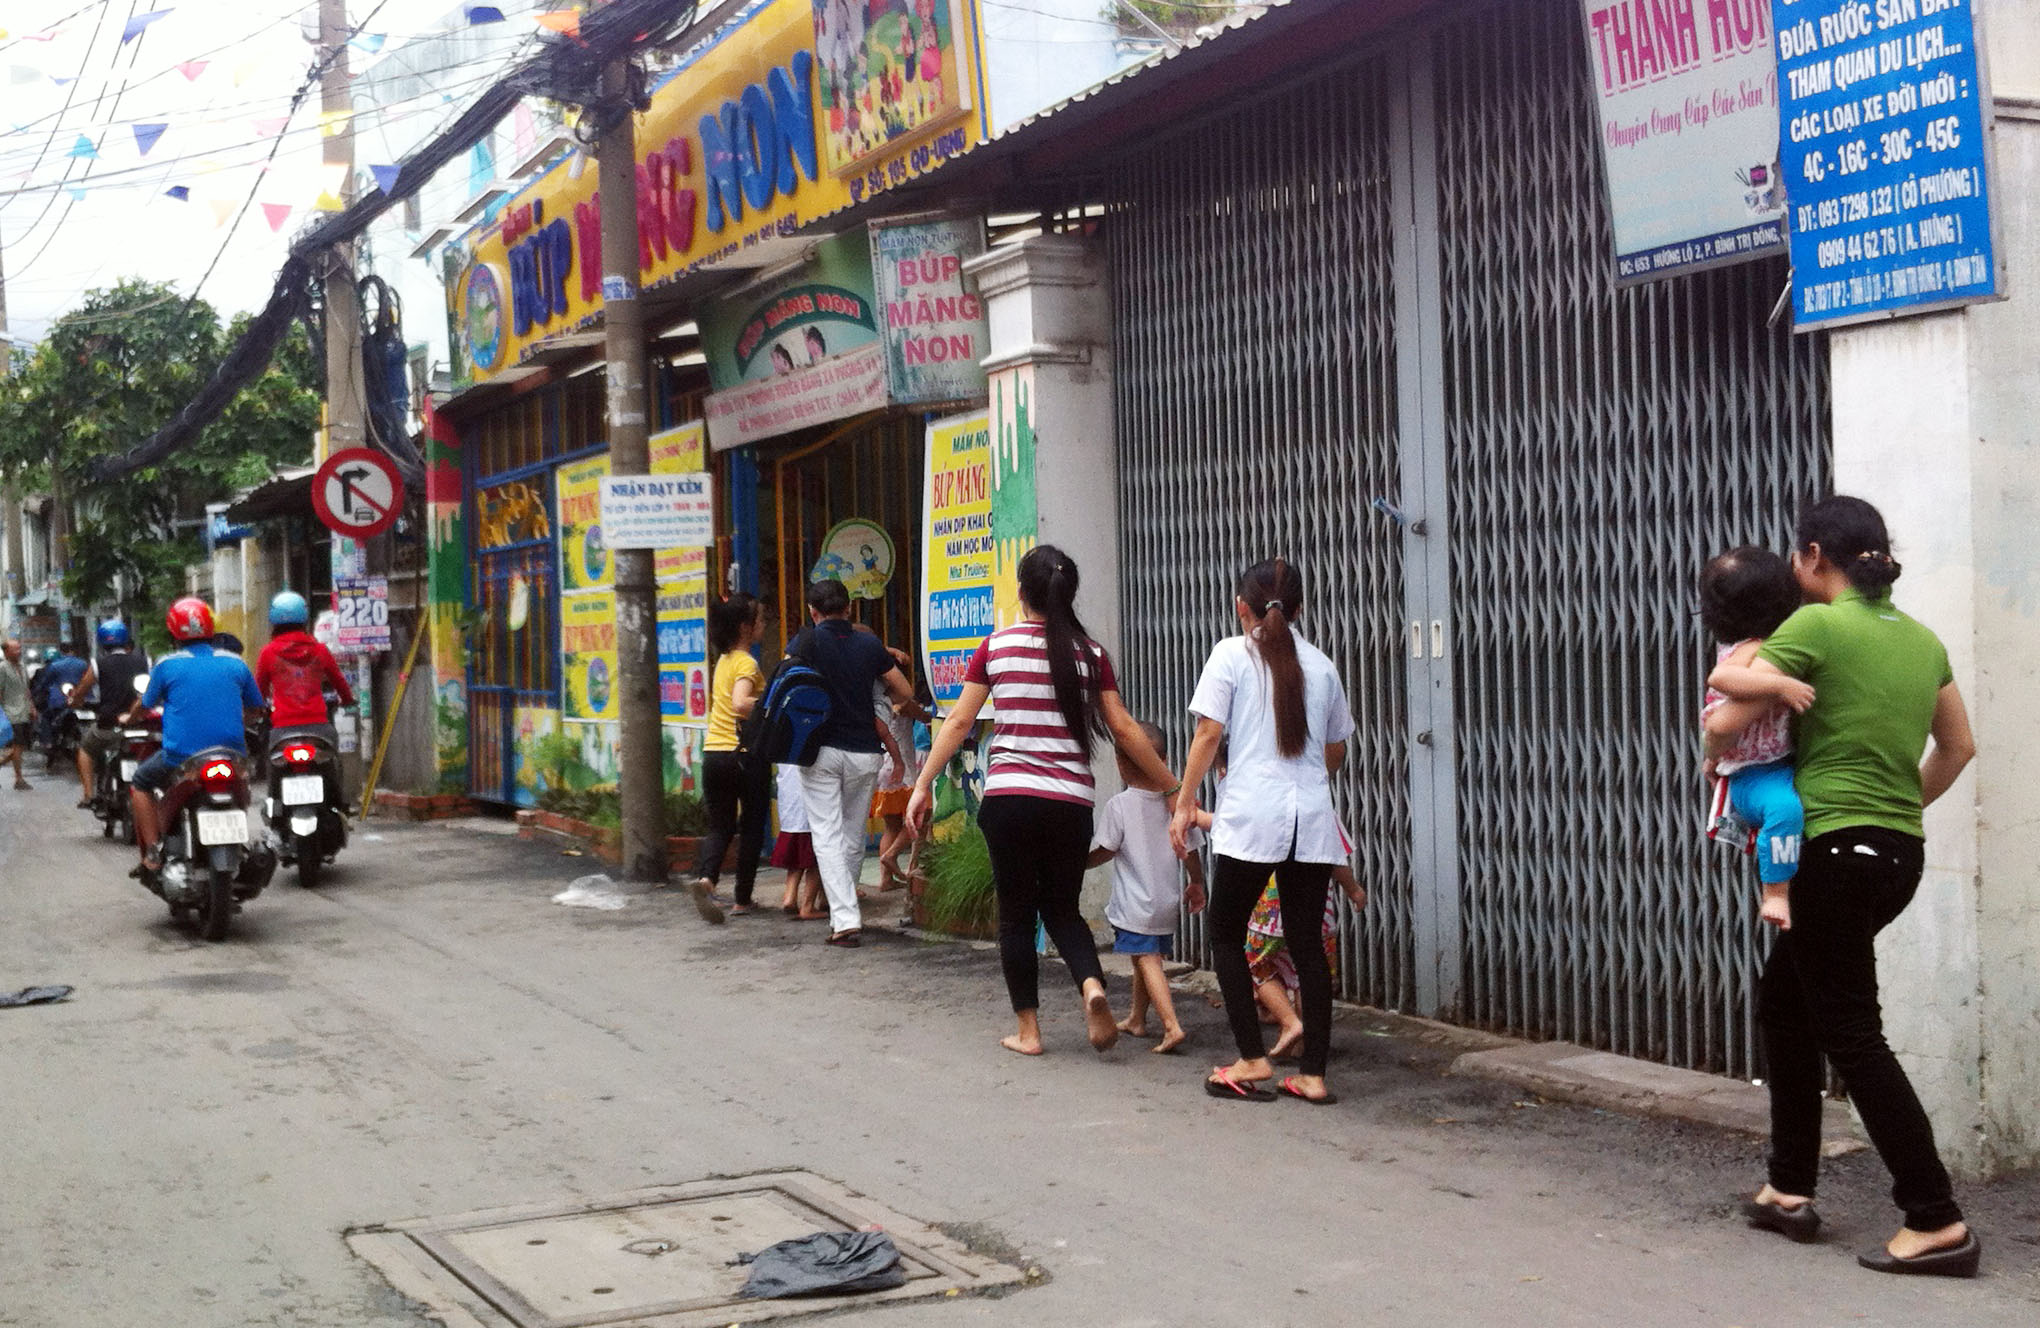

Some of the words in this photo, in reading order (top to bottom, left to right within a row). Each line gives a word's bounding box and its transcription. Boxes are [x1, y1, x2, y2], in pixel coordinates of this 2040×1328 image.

[1592, 0, 1701, 97] THANH
[1779, 17, 1819, 60] ĐƯA
[1819, 0, 1874, 48] RƯỚC
[1787, 60, 1832, 101] THAM
[1834, 46, 1877, 92] QUAN
[1879, 38, 1902, 75] DU
[1790, 109, 1821, 143] CÁC
[1823, 101, 1861, 133] LOẠI
[1862, 94, 1885, 124] XE
[1887, 81, 1918, 117] ĐỜI
[1920, 70, 1956, 108] MỚI
[698, 49, 818, 235] NON
[1803, 150, 1825, 184] 4C
[1837, 139, 1869, 176] 16C
[1880, 128, 1913, 165] 30C
[1926, 115, 1961, 153] 45C
[1798, 203, 1818, 233] ĐT:
[1818, 198, 1841, 229] 093
[1840, 191, 1870, 223] 7298
[1871, 185, 1893, 217] 132
[1901, 172, 1919, 210] CÔ
[898, 250, 962, 287] BÚP
[1818, 237, 1846, 269] 0909
[1847, 234, 1863, 263] 44
[1863, 231, 1880, 260] 62
[1880, 227, 1897, 257] 76
[815, 292, 861, 320] NON
[887, 293, 984, 329] MĂNG
[904, 334, 975, 366] NON
[933, 461, 954, 509] BÚP
[955, 460, 986, 505] MĂNG
[933, 516, 953, 537] NHÂN
[967, 513, 986, 531] KHAI
[963, 537, 980, 559] HỌC
[339, 597, 389, 628] 220
